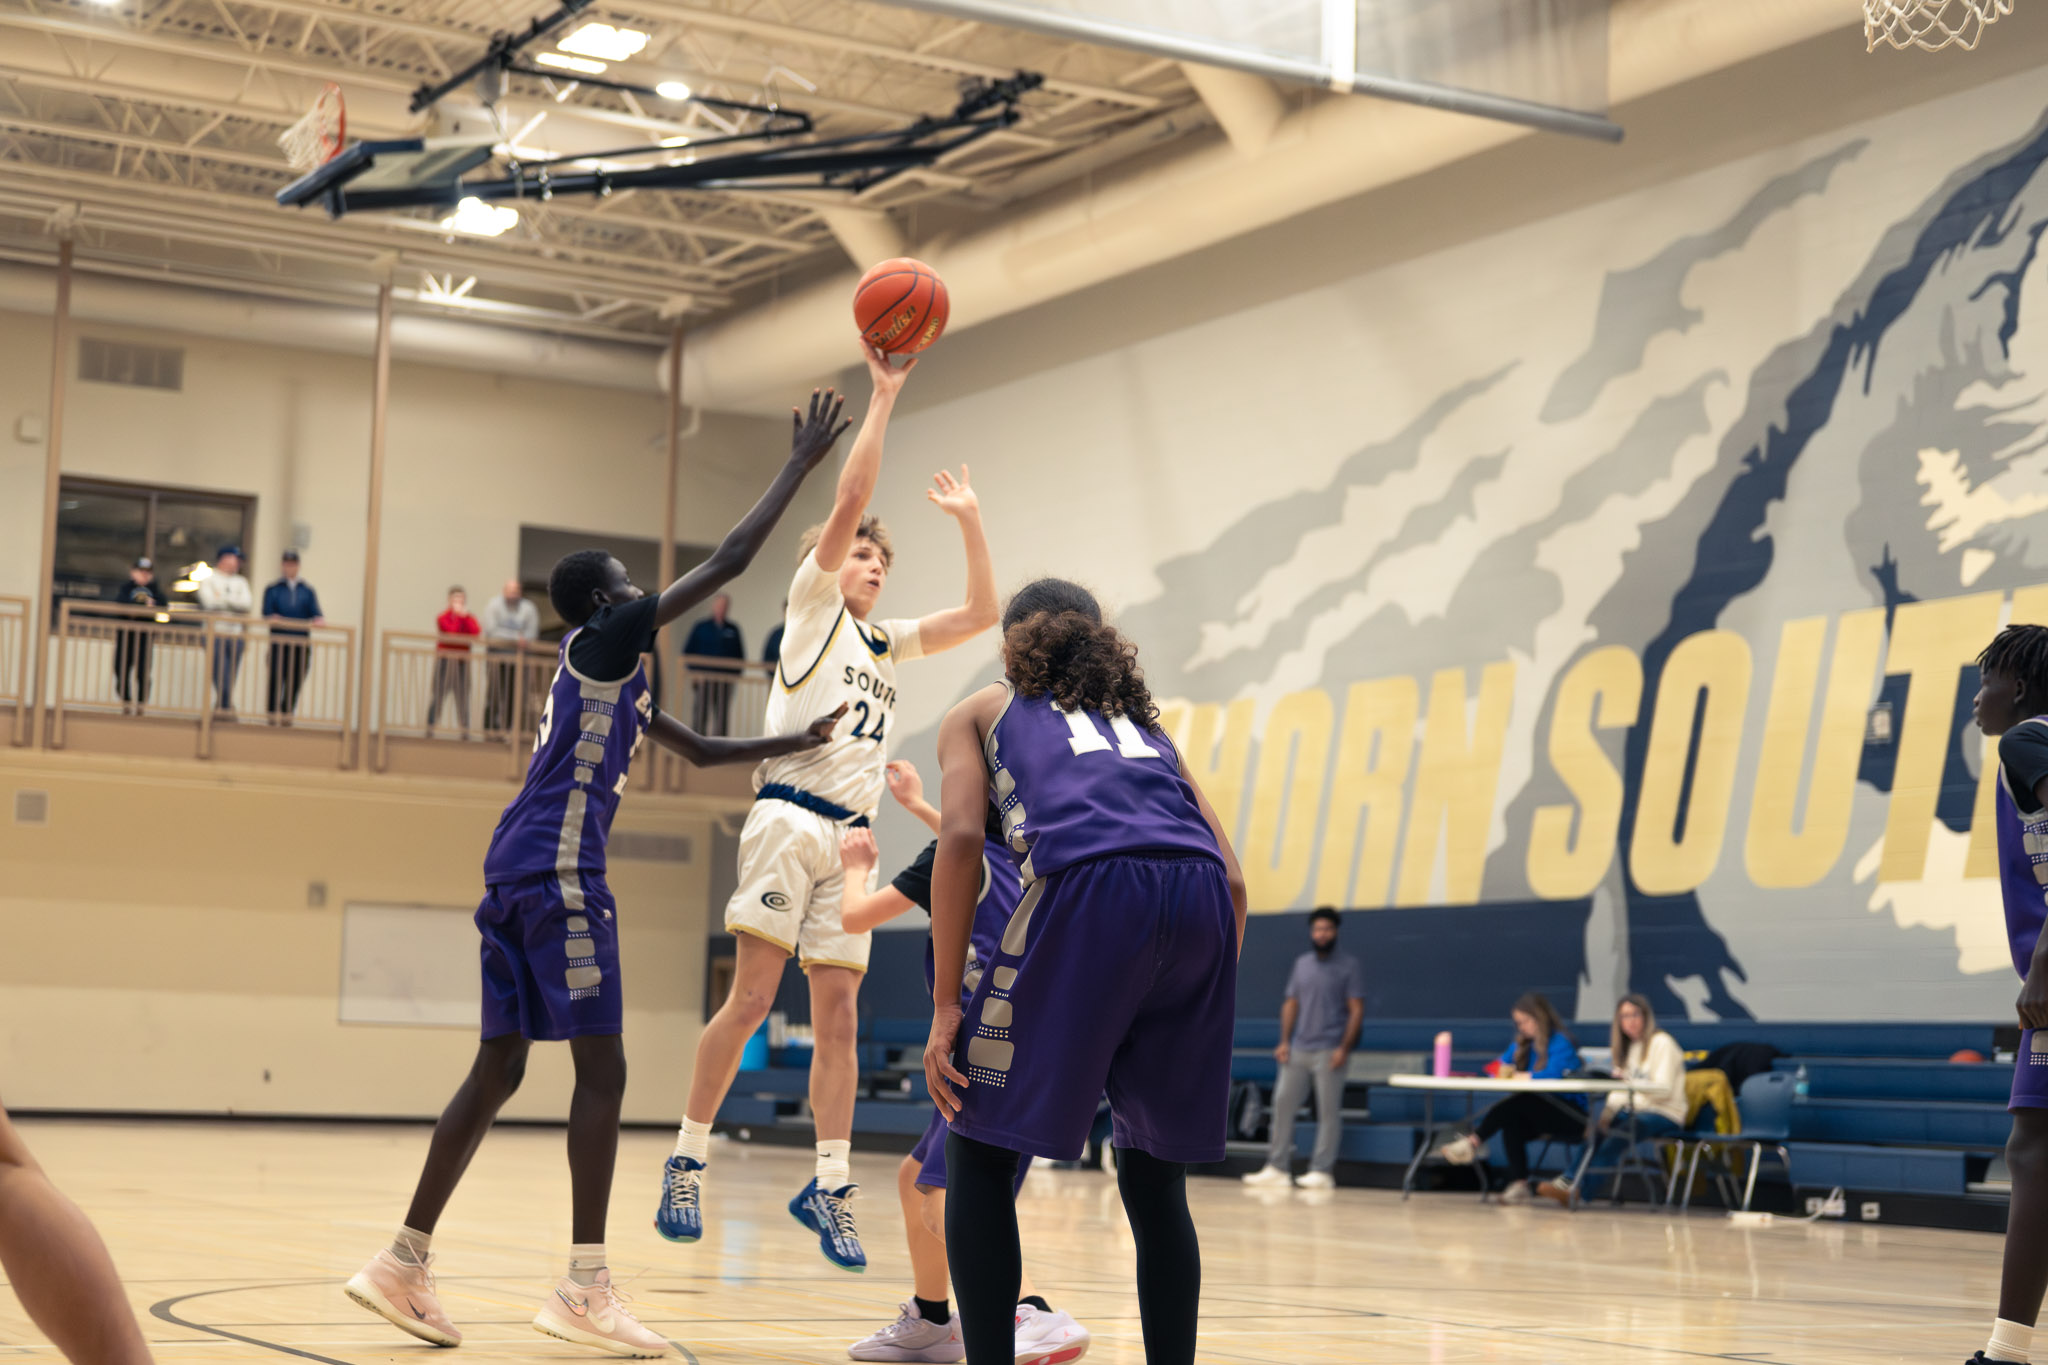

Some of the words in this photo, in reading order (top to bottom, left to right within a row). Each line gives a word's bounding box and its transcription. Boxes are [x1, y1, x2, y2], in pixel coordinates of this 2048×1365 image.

[850, 700, 885, 745] 24
[1050, 699, 1161, 759] 11
[1156, 661, 1518, 914] HORN
